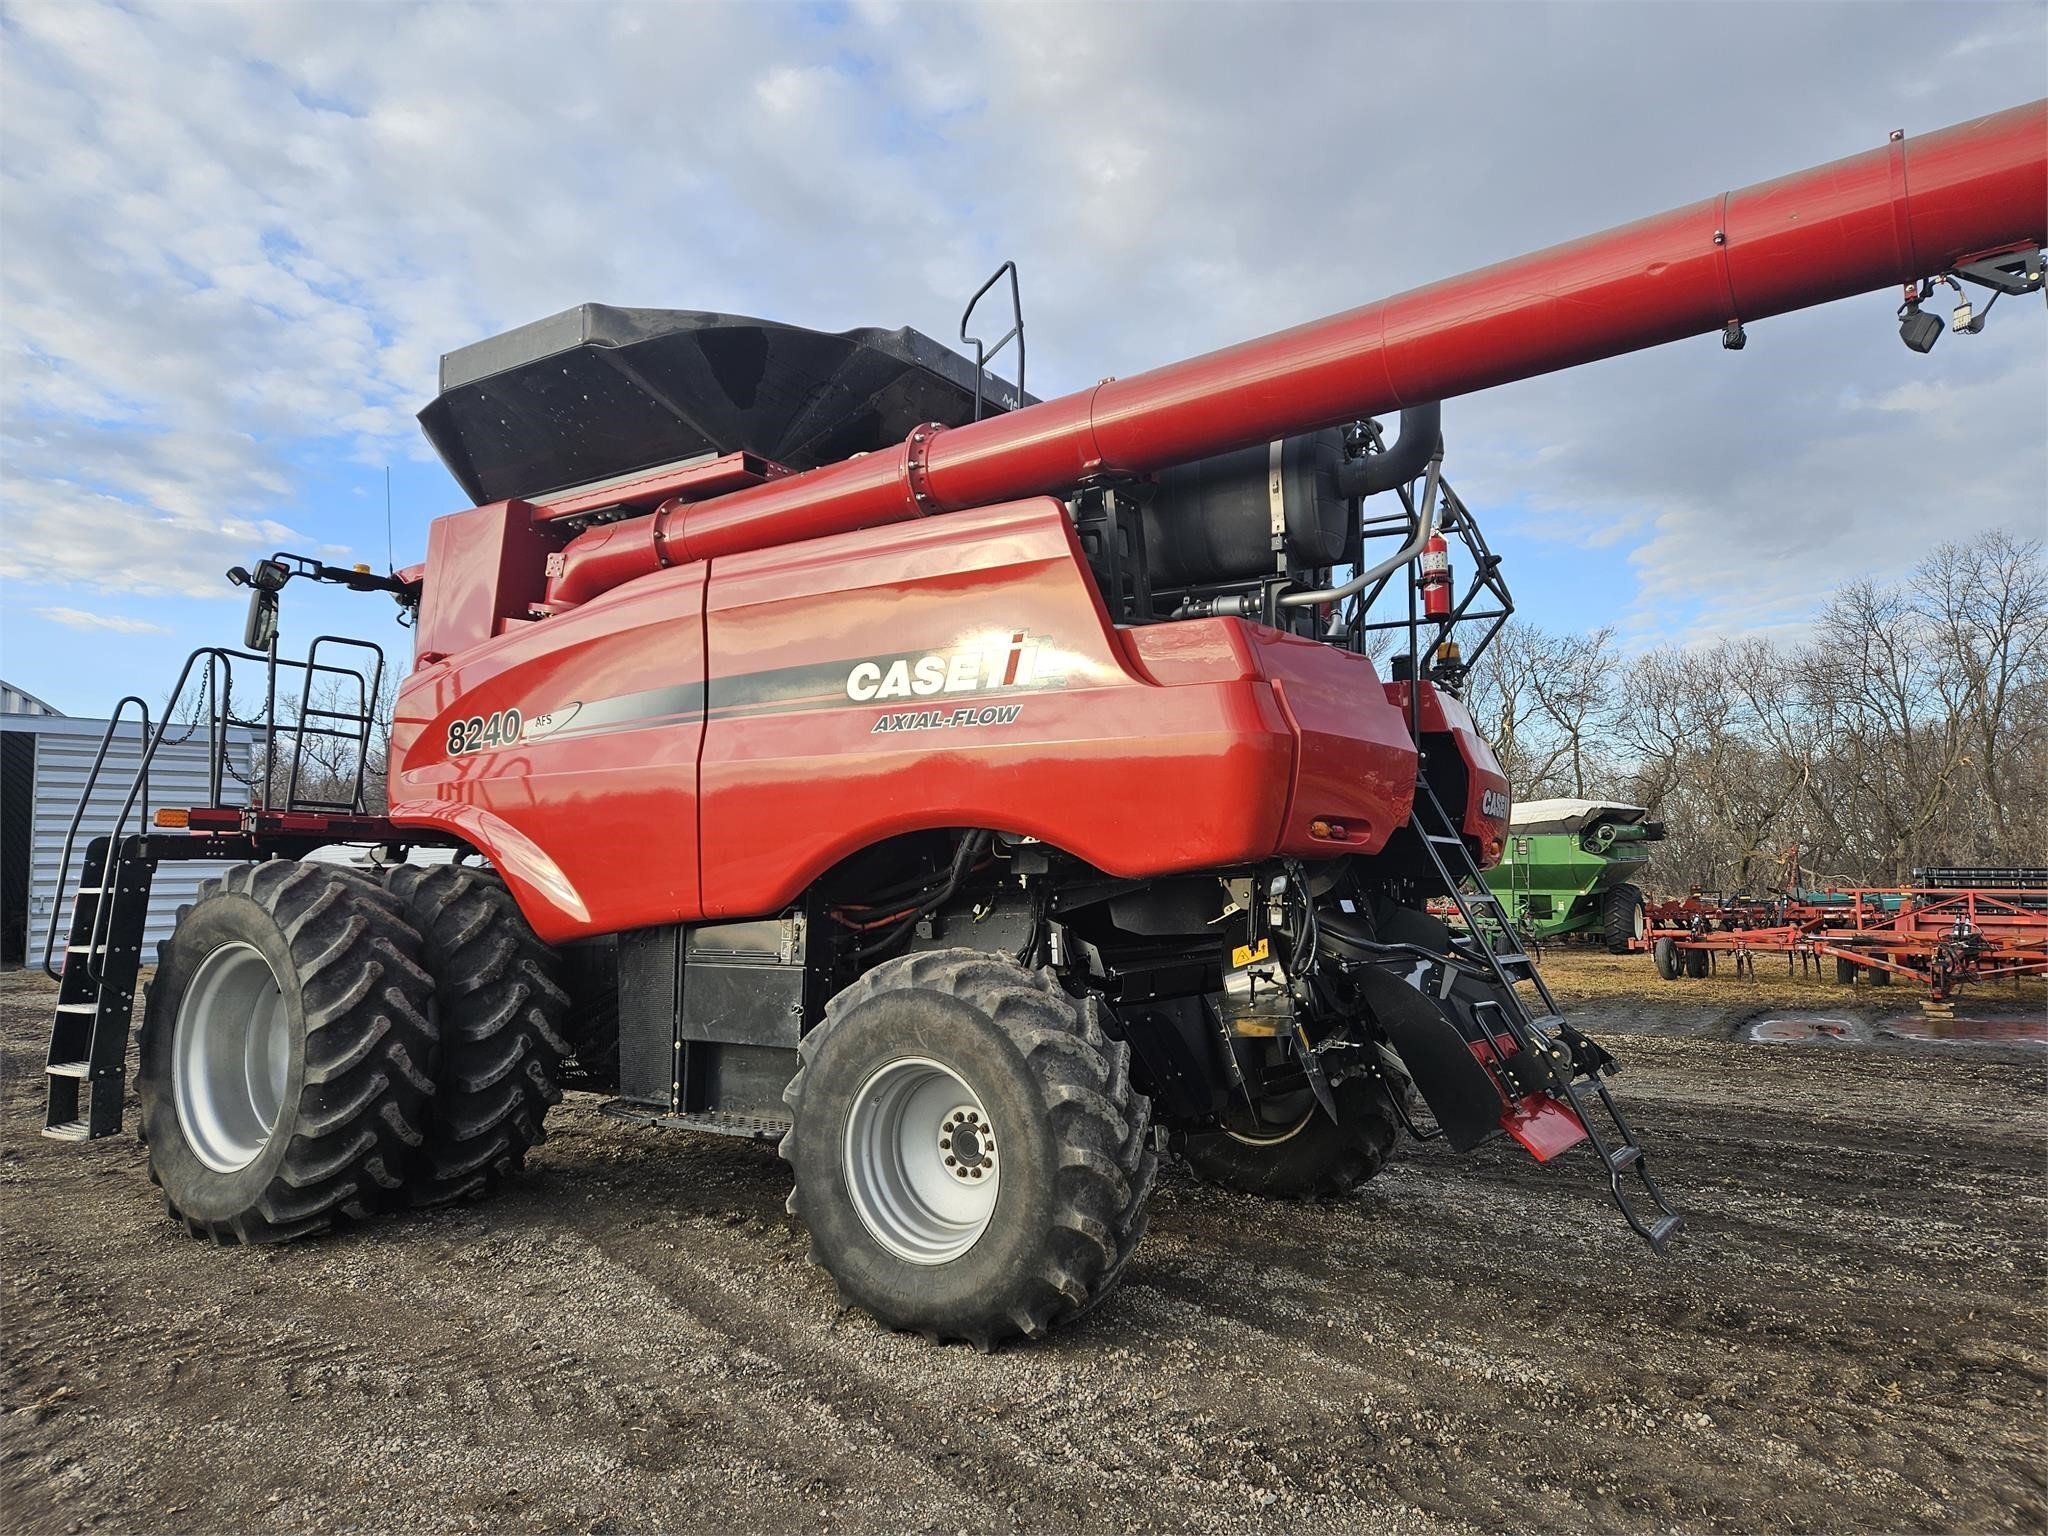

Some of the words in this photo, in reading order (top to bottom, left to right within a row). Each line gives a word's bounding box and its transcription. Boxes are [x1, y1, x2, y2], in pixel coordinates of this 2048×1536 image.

[846, 652, 983, 701] CASE
[447, 708, 521, 756] 8240
[535, 714, 552, 728] AFS
[870, 704, 1023, 734] AXIAL-FLOW
